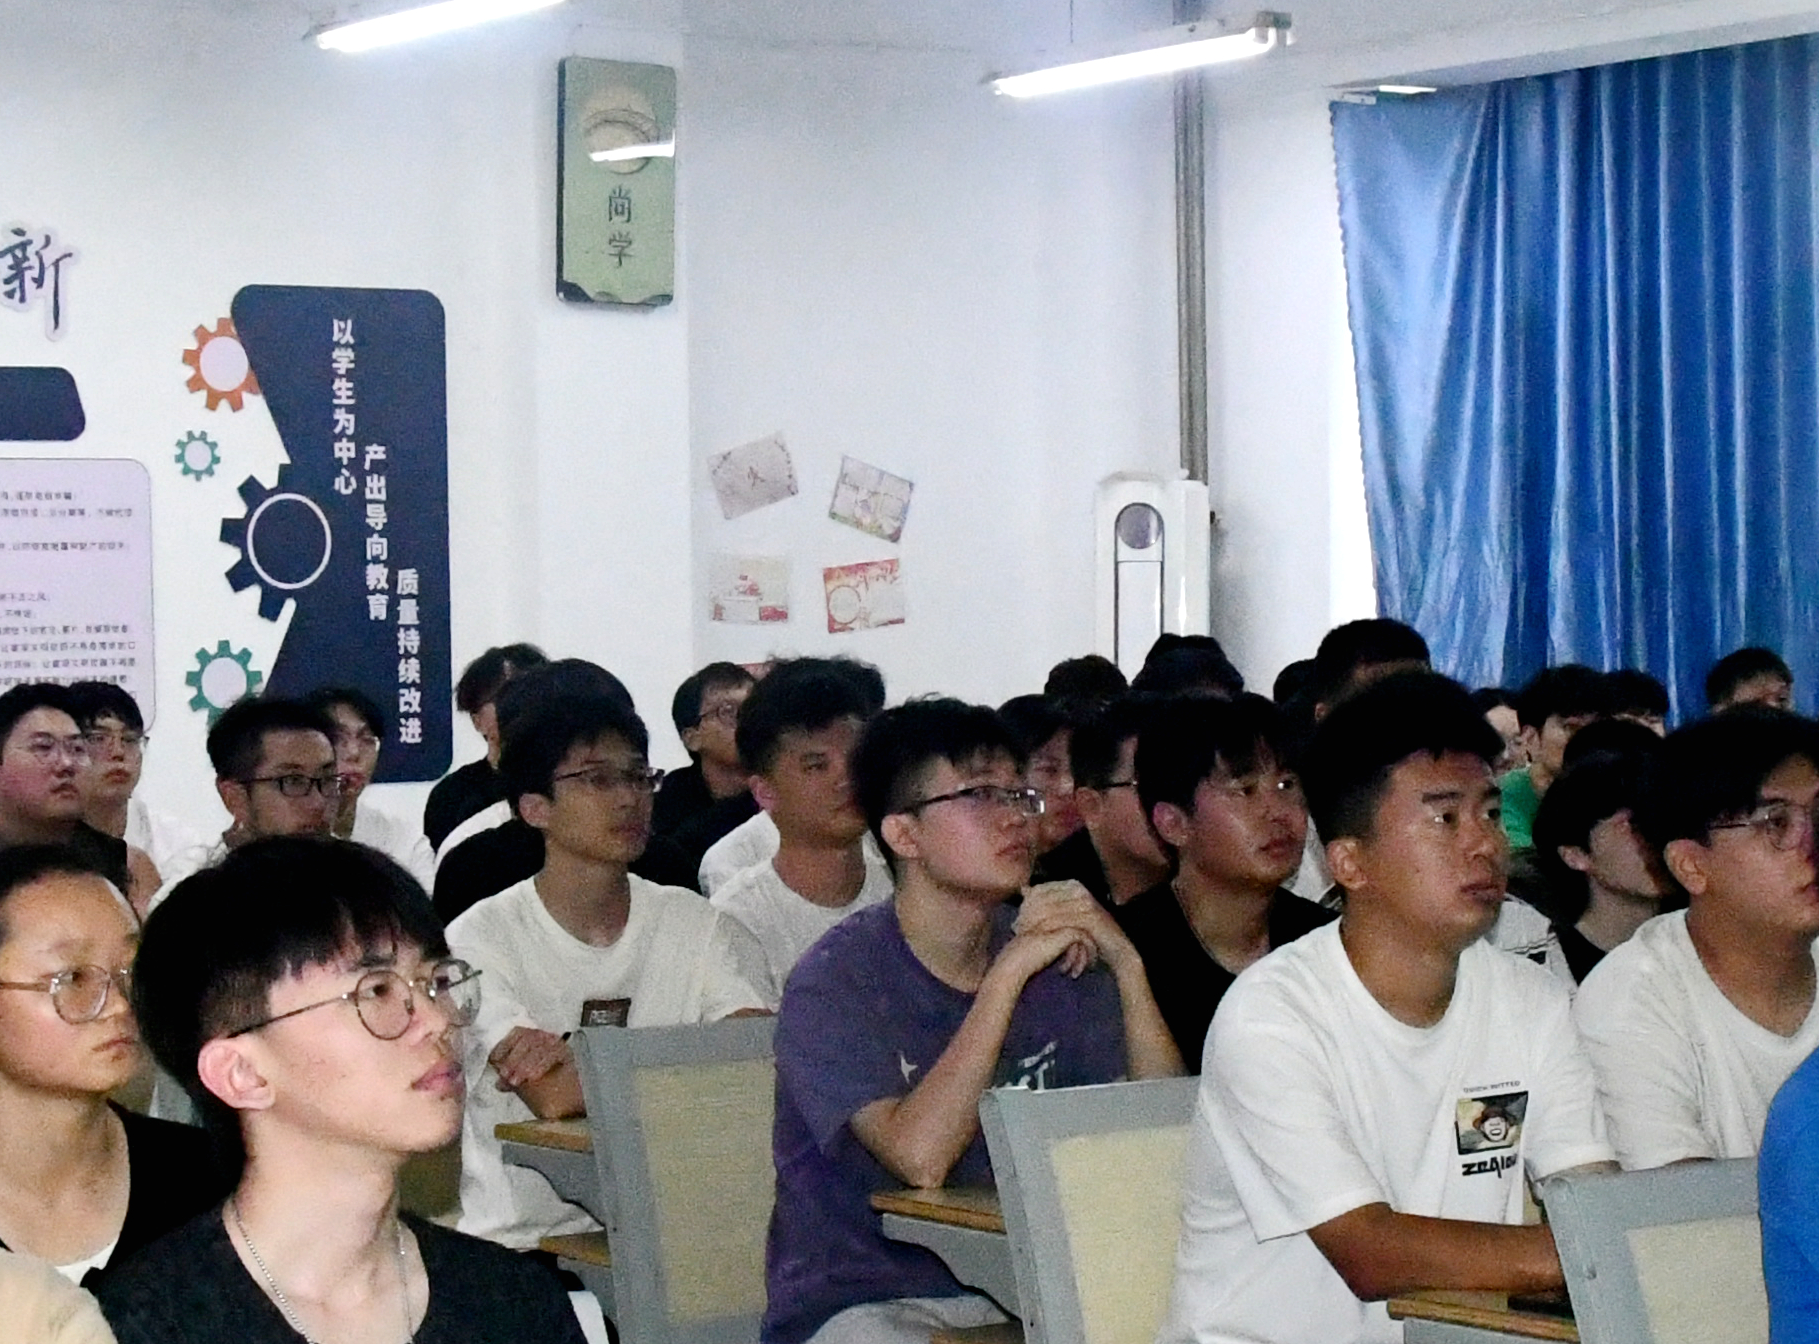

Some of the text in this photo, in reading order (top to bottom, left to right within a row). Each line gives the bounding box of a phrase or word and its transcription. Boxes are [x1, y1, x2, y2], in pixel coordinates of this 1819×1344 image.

[608, 185, 634, 268] 尚学
[332, 319, 357, 496] 以学生为中心
[364, 444, 389, 622] 产出导向教育
[396, 568, 423, 745] 质量持续改进
